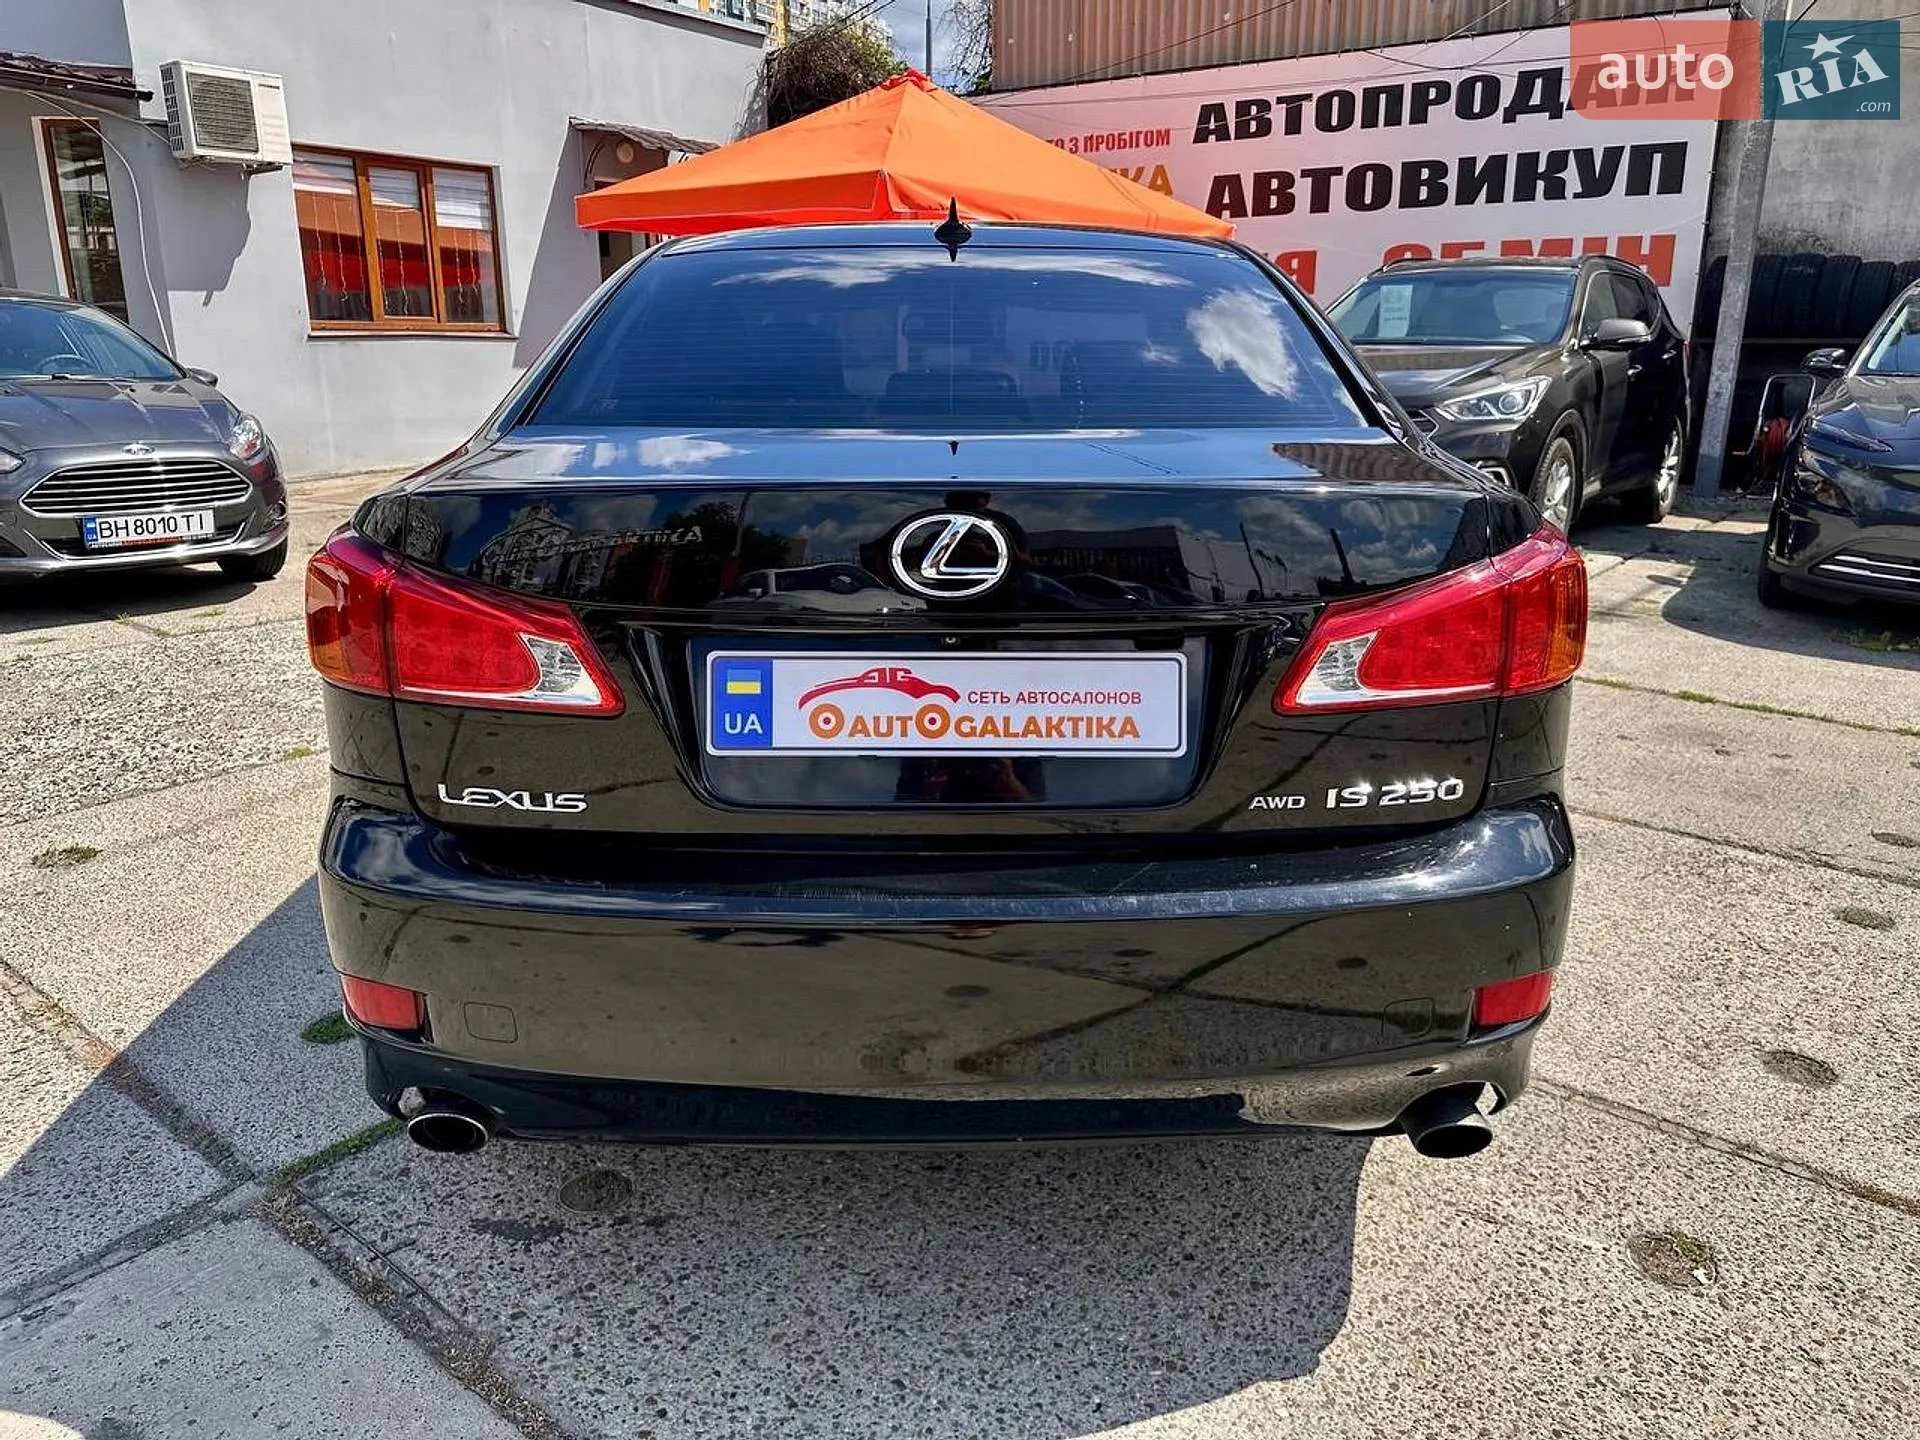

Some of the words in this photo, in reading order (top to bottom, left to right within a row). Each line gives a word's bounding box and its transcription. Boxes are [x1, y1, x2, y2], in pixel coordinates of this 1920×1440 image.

[1083, 128, 1171, 153] ПРОБІГОМ
[1206, 141, 1688, 219] АВТОВИКУП
[100, 520, 130, 538] BH
[133, 516, 178, 536] 8010
[968, 690, 1011, 705] СЕТЬ
[1016, 690, 1142, 705] АВТОСАЛОНОВ
[724, 713, 763, 735] UA
[437, 783, 588, 813] LEXUS
[1249, 796, 1306, 810] AWD
[1326, 783, 1373, 809] IS
[1379, 778, 1464, 807] 250
